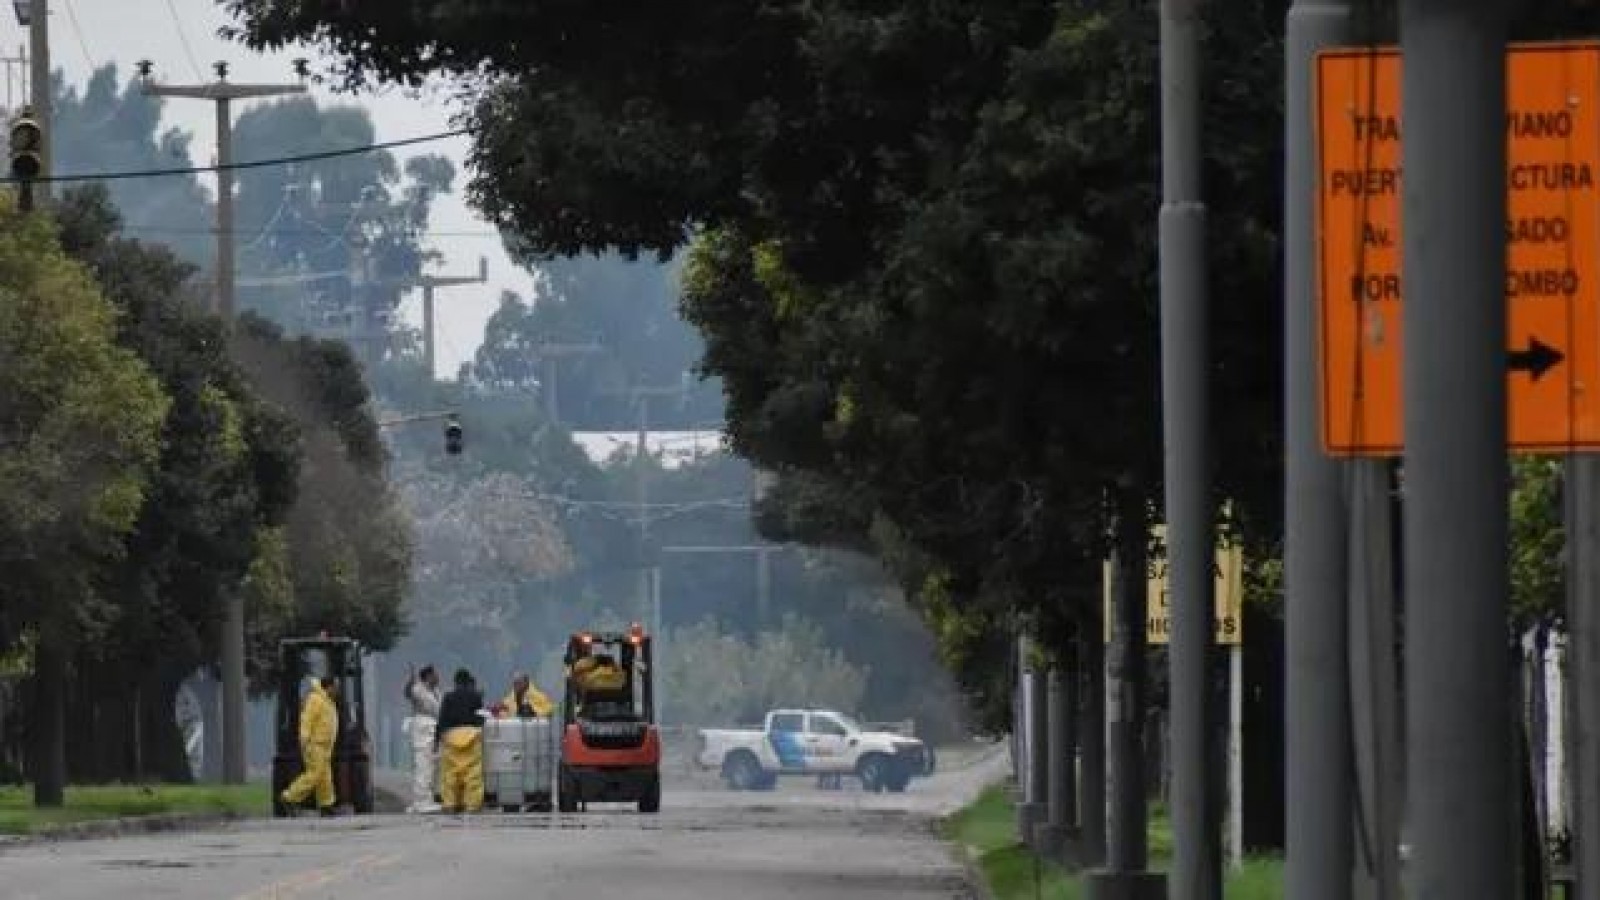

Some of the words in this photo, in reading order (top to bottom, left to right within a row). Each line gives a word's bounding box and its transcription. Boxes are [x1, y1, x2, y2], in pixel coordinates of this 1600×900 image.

[1353, 115, 1399, 141] TRA
[1331, 168, 1402, 197] PUER
[1511, 162, 1593, 191] CTURA
[1505, 215, 1568, 244] SADO
[1505, 269, 1579, 298] OMBO
